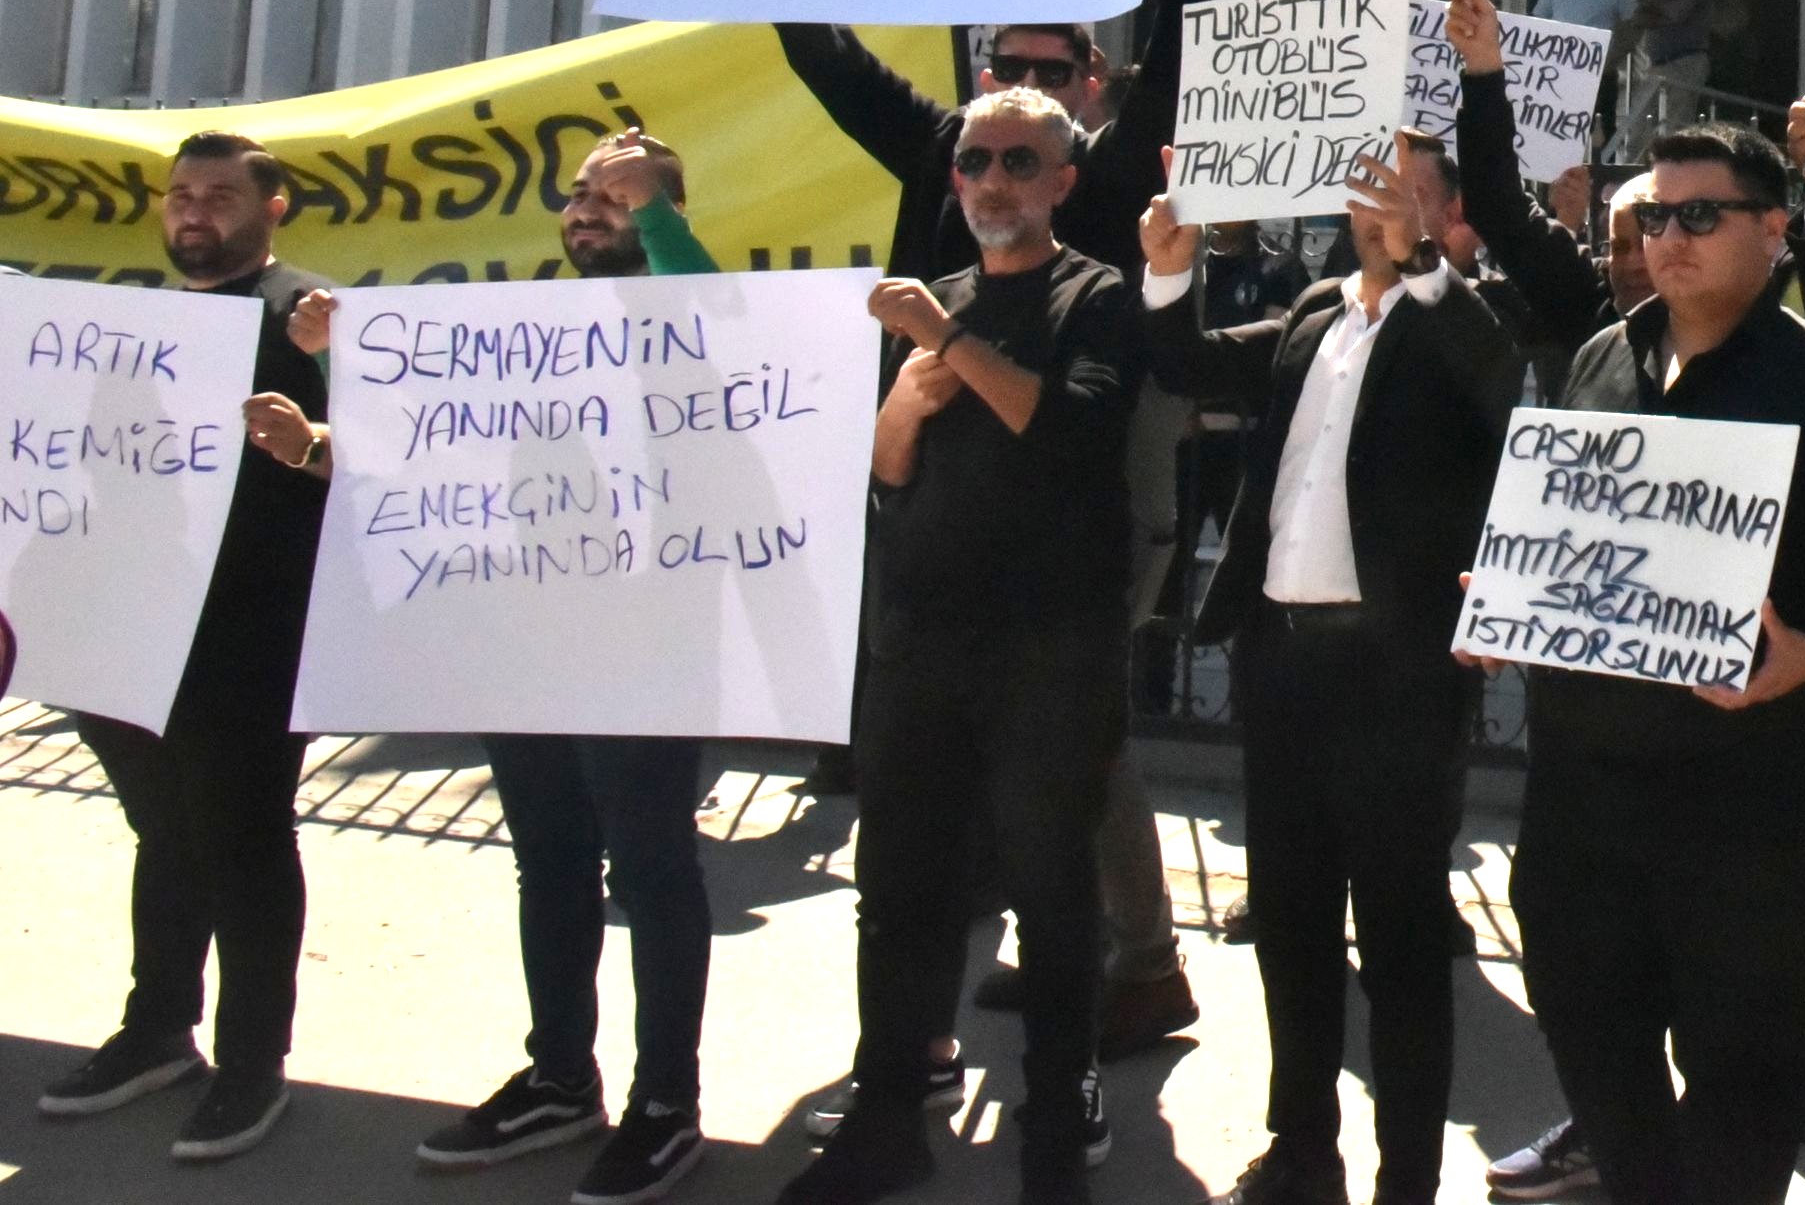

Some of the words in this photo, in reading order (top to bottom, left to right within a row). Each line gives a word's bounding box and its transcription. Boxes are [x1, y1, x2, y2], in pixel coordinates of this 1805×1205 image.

[1212, 34, 1368, 75] OTOBÜS
[1183, 79, 1367, 125] MİNİBÜS
[1174, 130, 1300, 187] TAKSİCİ
[29, 321, 180, 382] ARTIK
[359, 311, 706, 384] SERMAYENİN
[11, 418, 220, 476] KEMİĞE
[401, 394, 609, 461] YANINDA
[643, 365, 822, 440] DEĞİL
[1509, 421, 1645, 474] CASINO
[1541, 468, 1781, 548] ARAÇLARINA
[399, 527, 637, 600] YANINDA
[657, 516, 808, 571] OLUN
[1479, 522, 1653, 592] İMTİYAZ
[1465, 597, 1747, 693] İSTİYORSUNUZ
[1528, 581, 1758, 653] SAĞLAMAK
